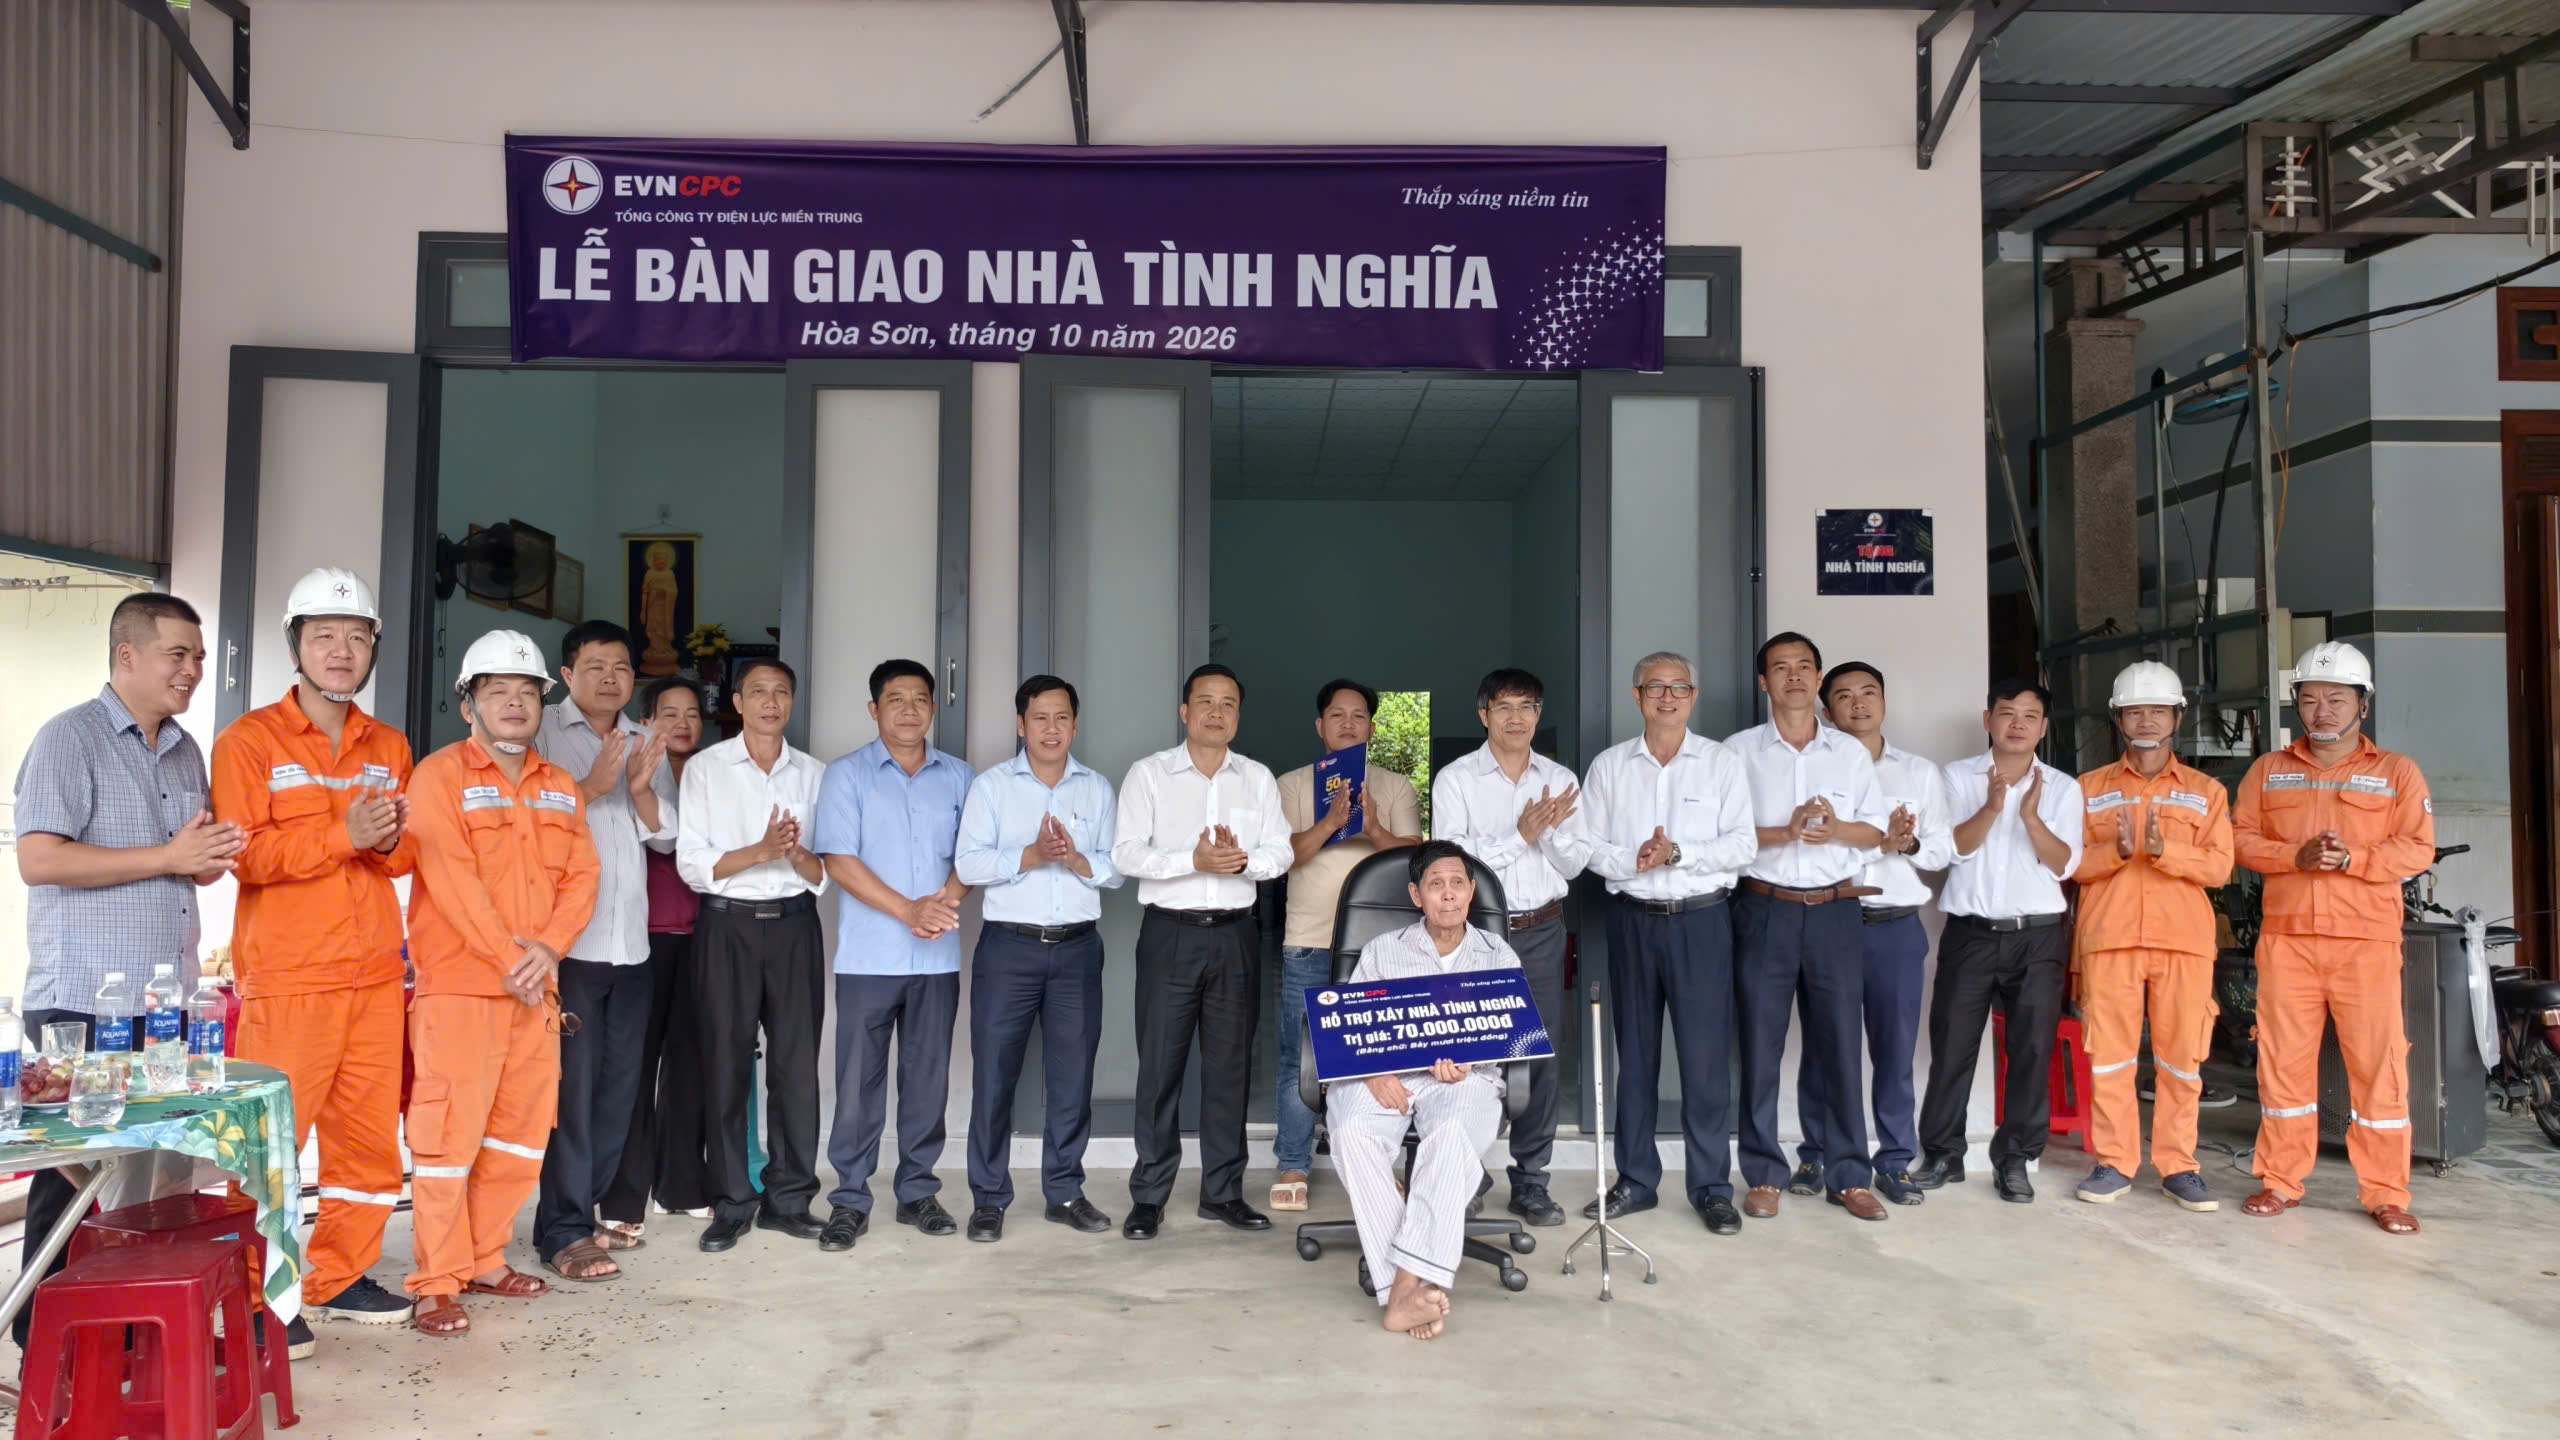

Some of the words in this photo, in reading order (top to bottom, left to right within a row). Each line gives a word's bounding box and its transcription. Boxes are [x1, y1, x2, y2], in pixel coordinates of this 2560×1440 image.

[614, 175, 741, 197] EVNCPC
[1402, 184, 1452, 208] Thắp
[1457, 188, 1503, 210] sáng
[1508, 186, 1555, 207] niềm
[1562, 190, 1589, 208] tin
[655, 209, 695, 223] CÔNG
[697, 211, 714, 223] TY
[717, 209, 749, 225] ĐIỆN
[751, 211, 778, 225] LỰC
[816, 212, 863, 224] TRUNG
[539, 227, 611, 302] LỄ
[635, 237, 770, 303] BÀN
[793, 248, 944, 304] GIAO
[967, 239, 1104, 305] NHÀ
[1124, 240, 1273, 307] TÌNH
[1297, 244, 1499, 309] NGHĨA
[800, 321, 859, 346] Hòa
[869, 321, 936, 349] Sơn,
[948, 321, 1037, 352] tháng
[1049, 323, 1082, 347] 10
[1091, 323, 1156, 349] năm
[1164, 325, 1237, 351] 2026
[1825, 560, 1852, 573] NHÀ
[1855, 560, 1884, 573] TÌNH
[1887, 560, 1926, 573] NGHĨA
[153, 1018, 180, 1028] AQUAFIN
[1320, 1011, 1341, 1029] HỖ
[1343, 1010, 1373, 1026] TRỢ
[1375, 1006, 1404, 1023] XÂY
[1407, 1002, 1440, 1019] NHÀ
[1441, 1000, 1477, 1016] TÌNH
[1479, 994, 1527, 1012] NGHĨA
[1343, 1033, 1363, 1047] Trị
[1365, 1030, 1392, 1045] giá:
[1392, 1013, 1514, 1040] 70.000.000đ
